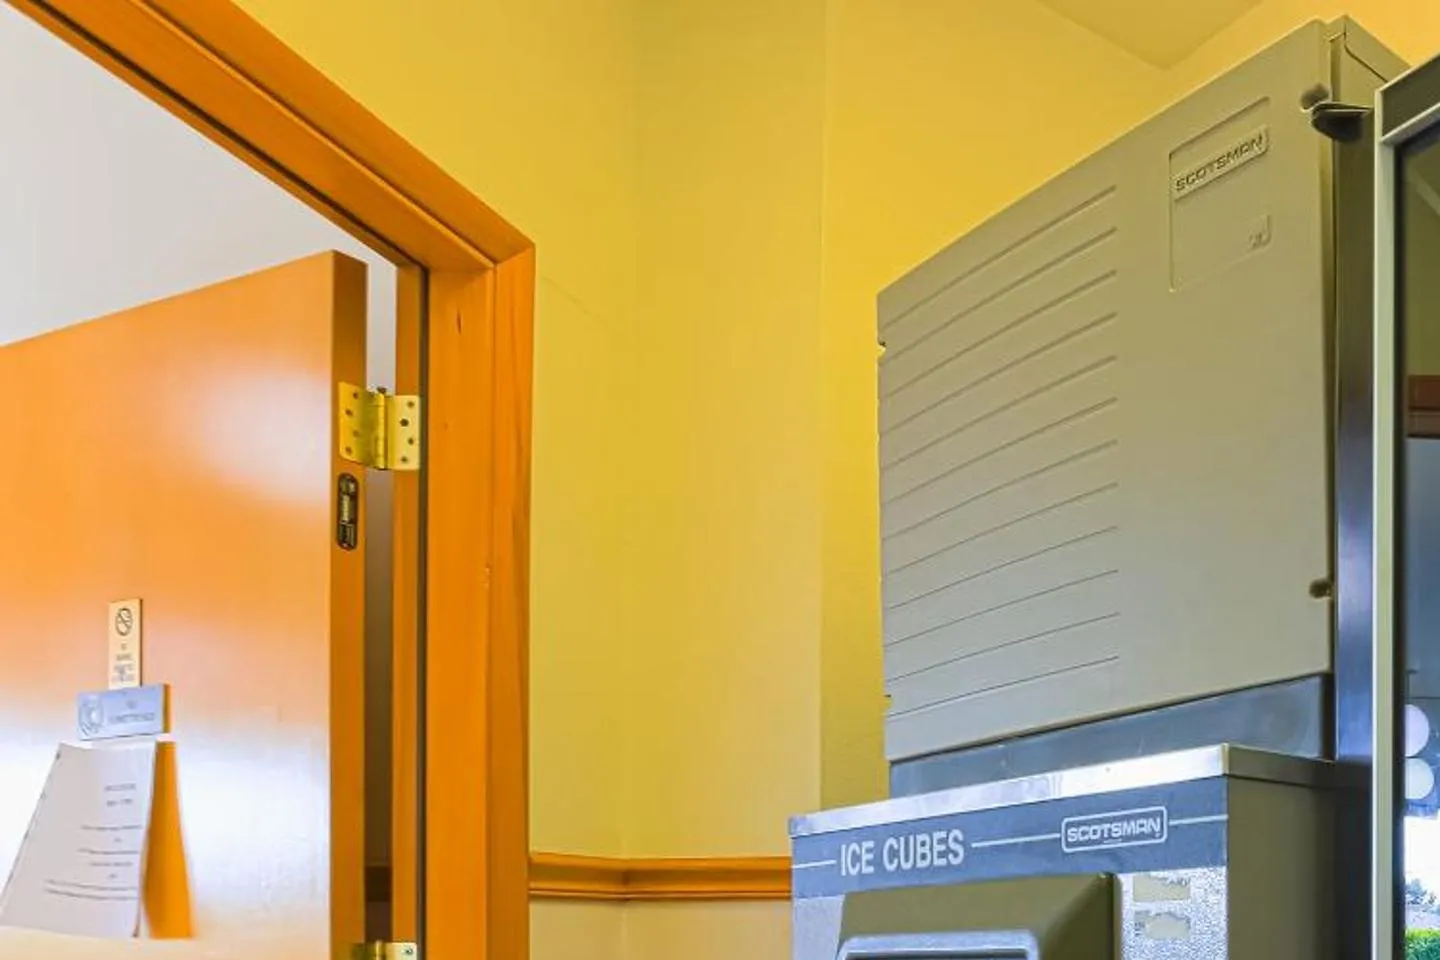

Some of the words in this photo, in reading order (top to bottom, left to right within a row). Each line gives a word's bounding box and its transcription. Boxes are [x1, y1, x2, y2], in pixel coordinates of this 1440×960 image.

[1174, 131, 1264, 193] SCOTSMAN
[840, 839, 875, 877] ICE
[882, 828, 965, 873] CUBES
[1066, 816, 1161, 843] SCOTSMAN
